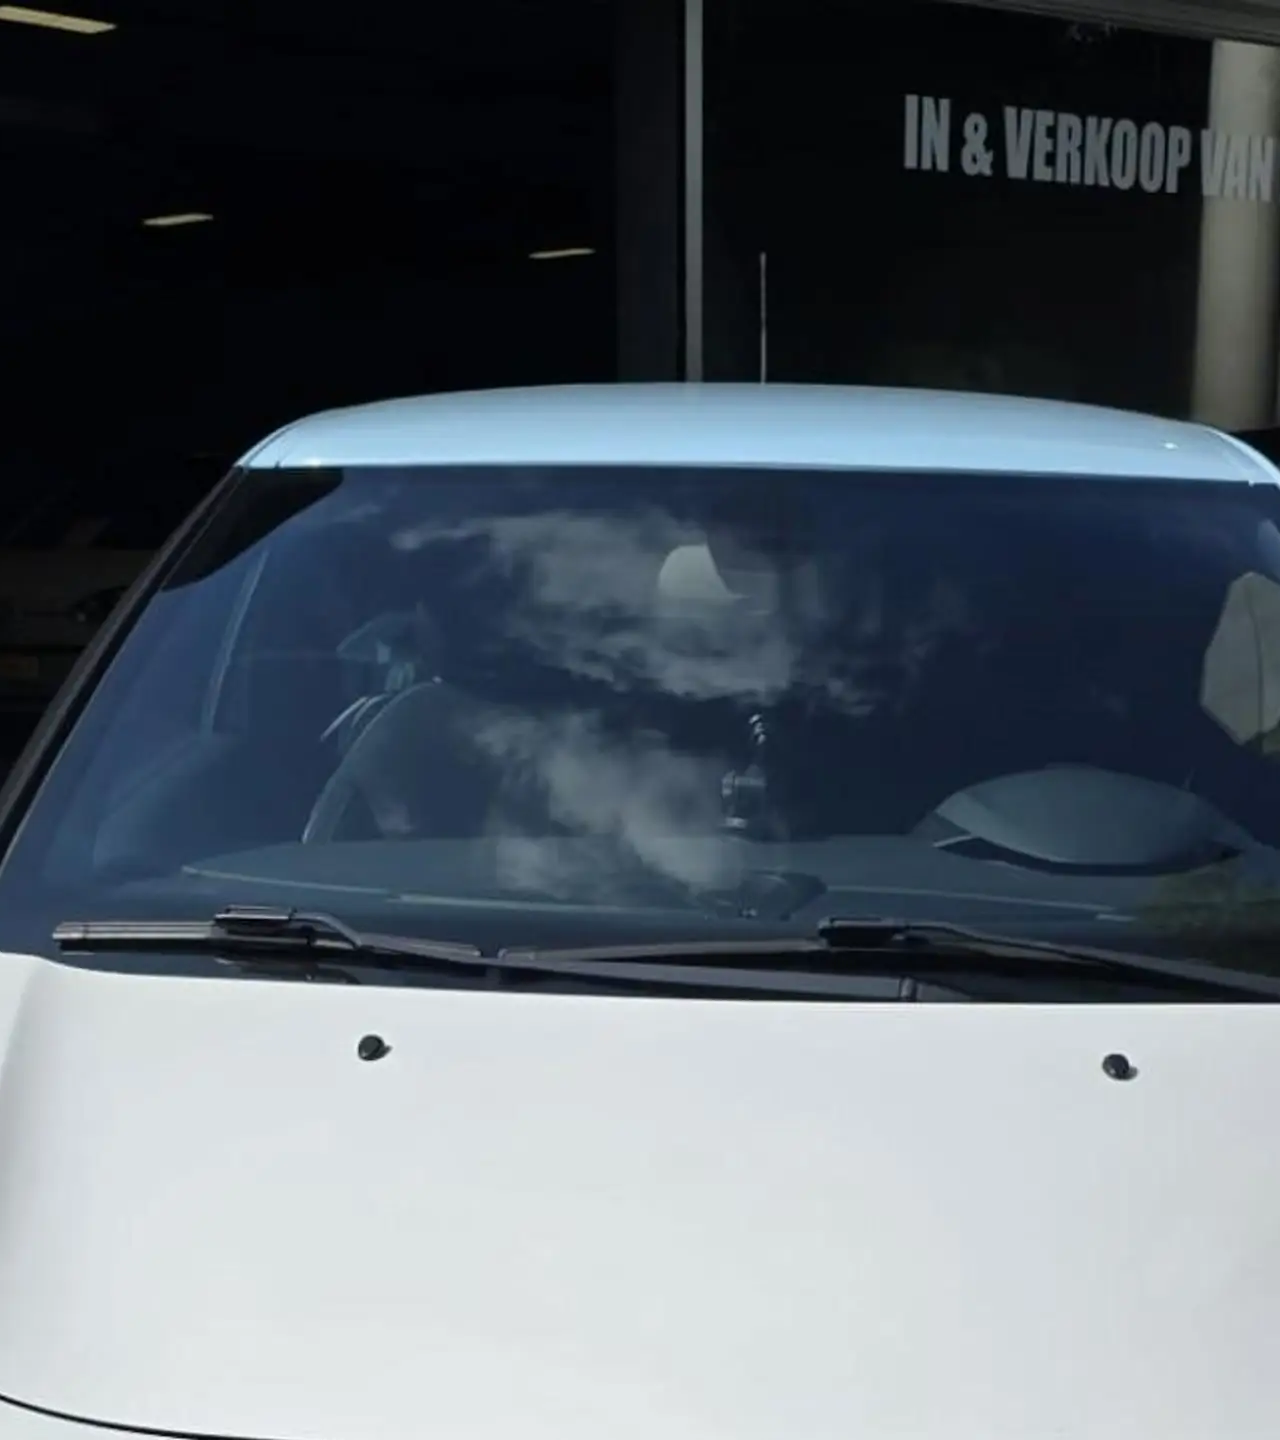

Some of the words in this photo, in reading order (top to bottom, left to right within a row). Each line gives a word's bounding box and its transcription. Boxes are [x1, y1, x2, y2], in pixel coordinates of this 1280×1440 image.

[904, 94, 950, 171] IN
[960, 112, 993, 176] &
[1005, 106, 1192, 193] VERKOOP
[1201, 128, 1274, 203] VAN
